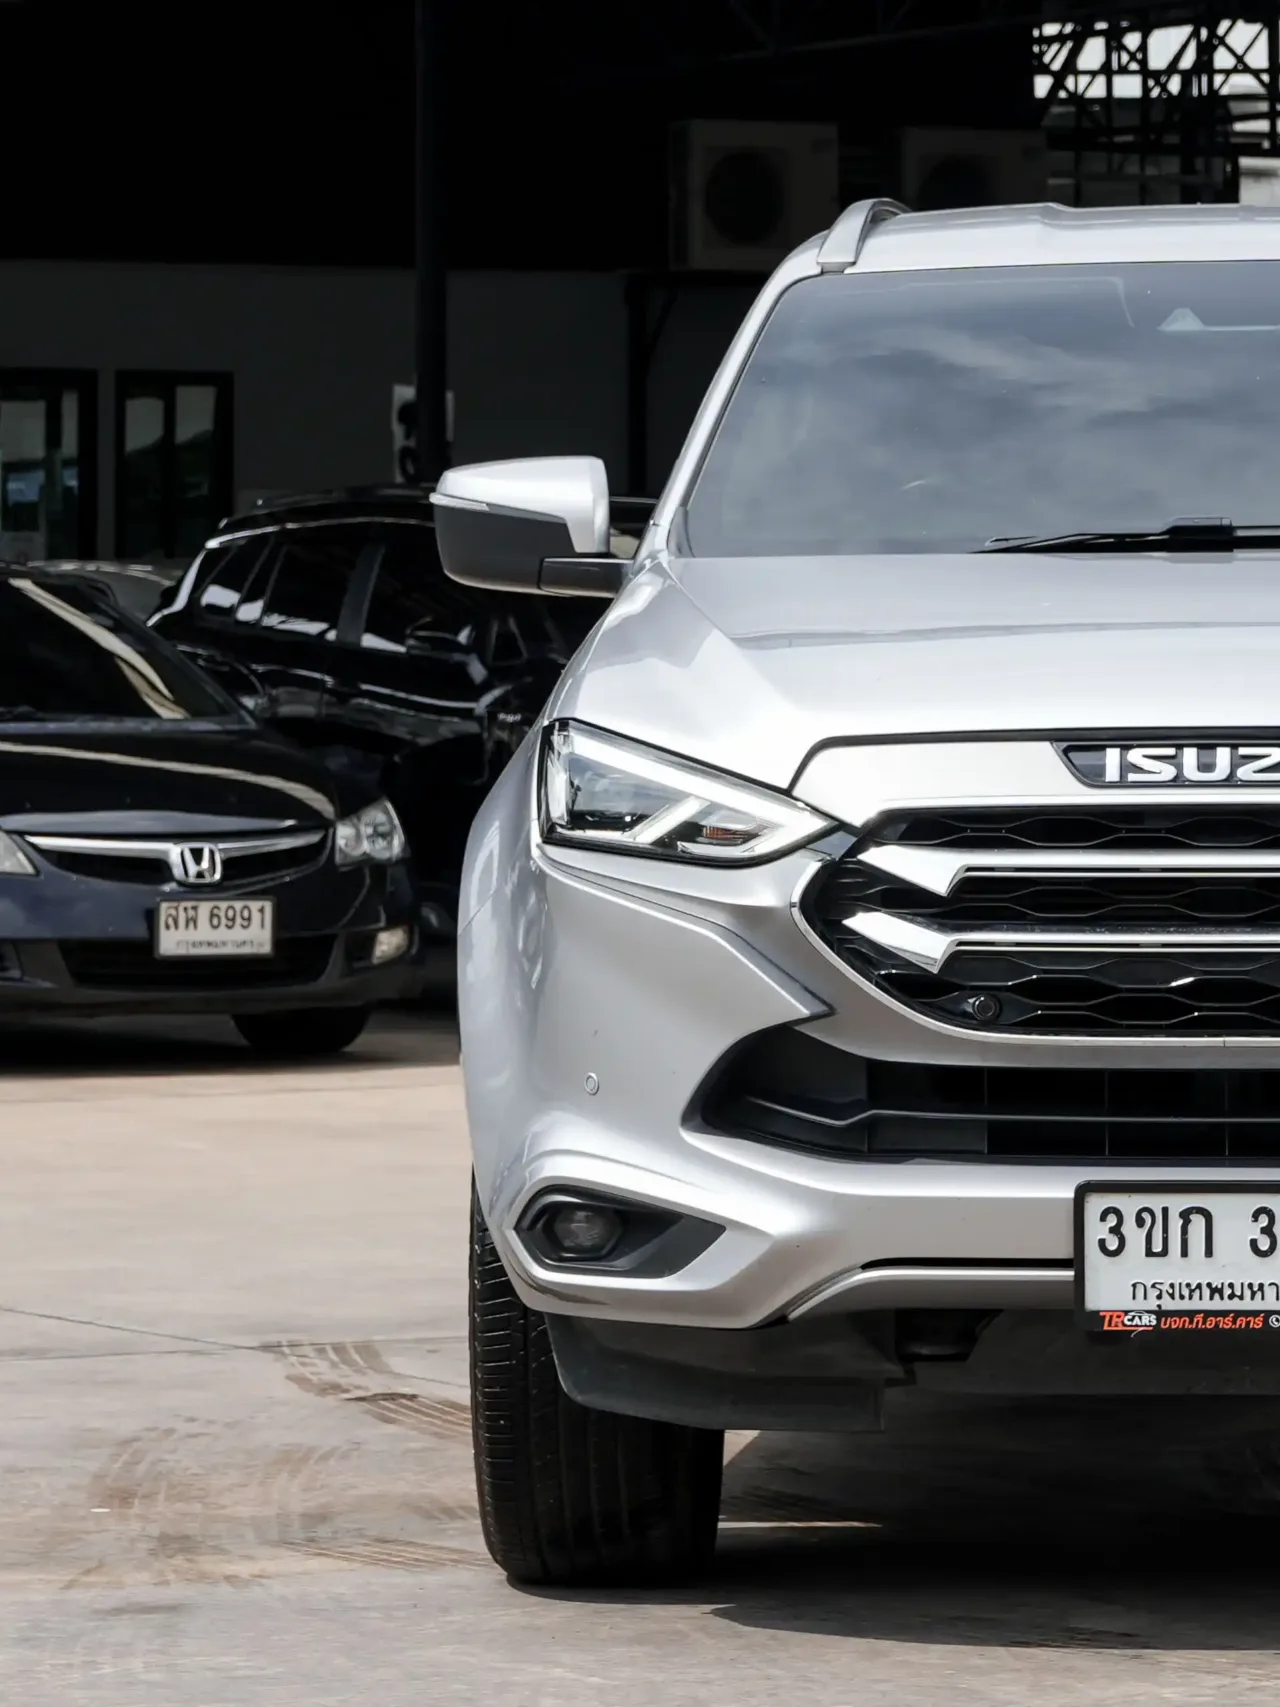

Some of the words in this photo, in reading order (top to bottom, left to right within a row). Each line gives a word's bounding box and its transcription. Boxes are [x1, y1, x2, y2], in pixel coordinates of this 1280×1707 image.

[209, 905, 265, 929] 6991
[1097, 1206, 1214, 1258] 3ขก
[1160, 1312, 1265, 1330] บจก.ที.อาร์.คาร์
